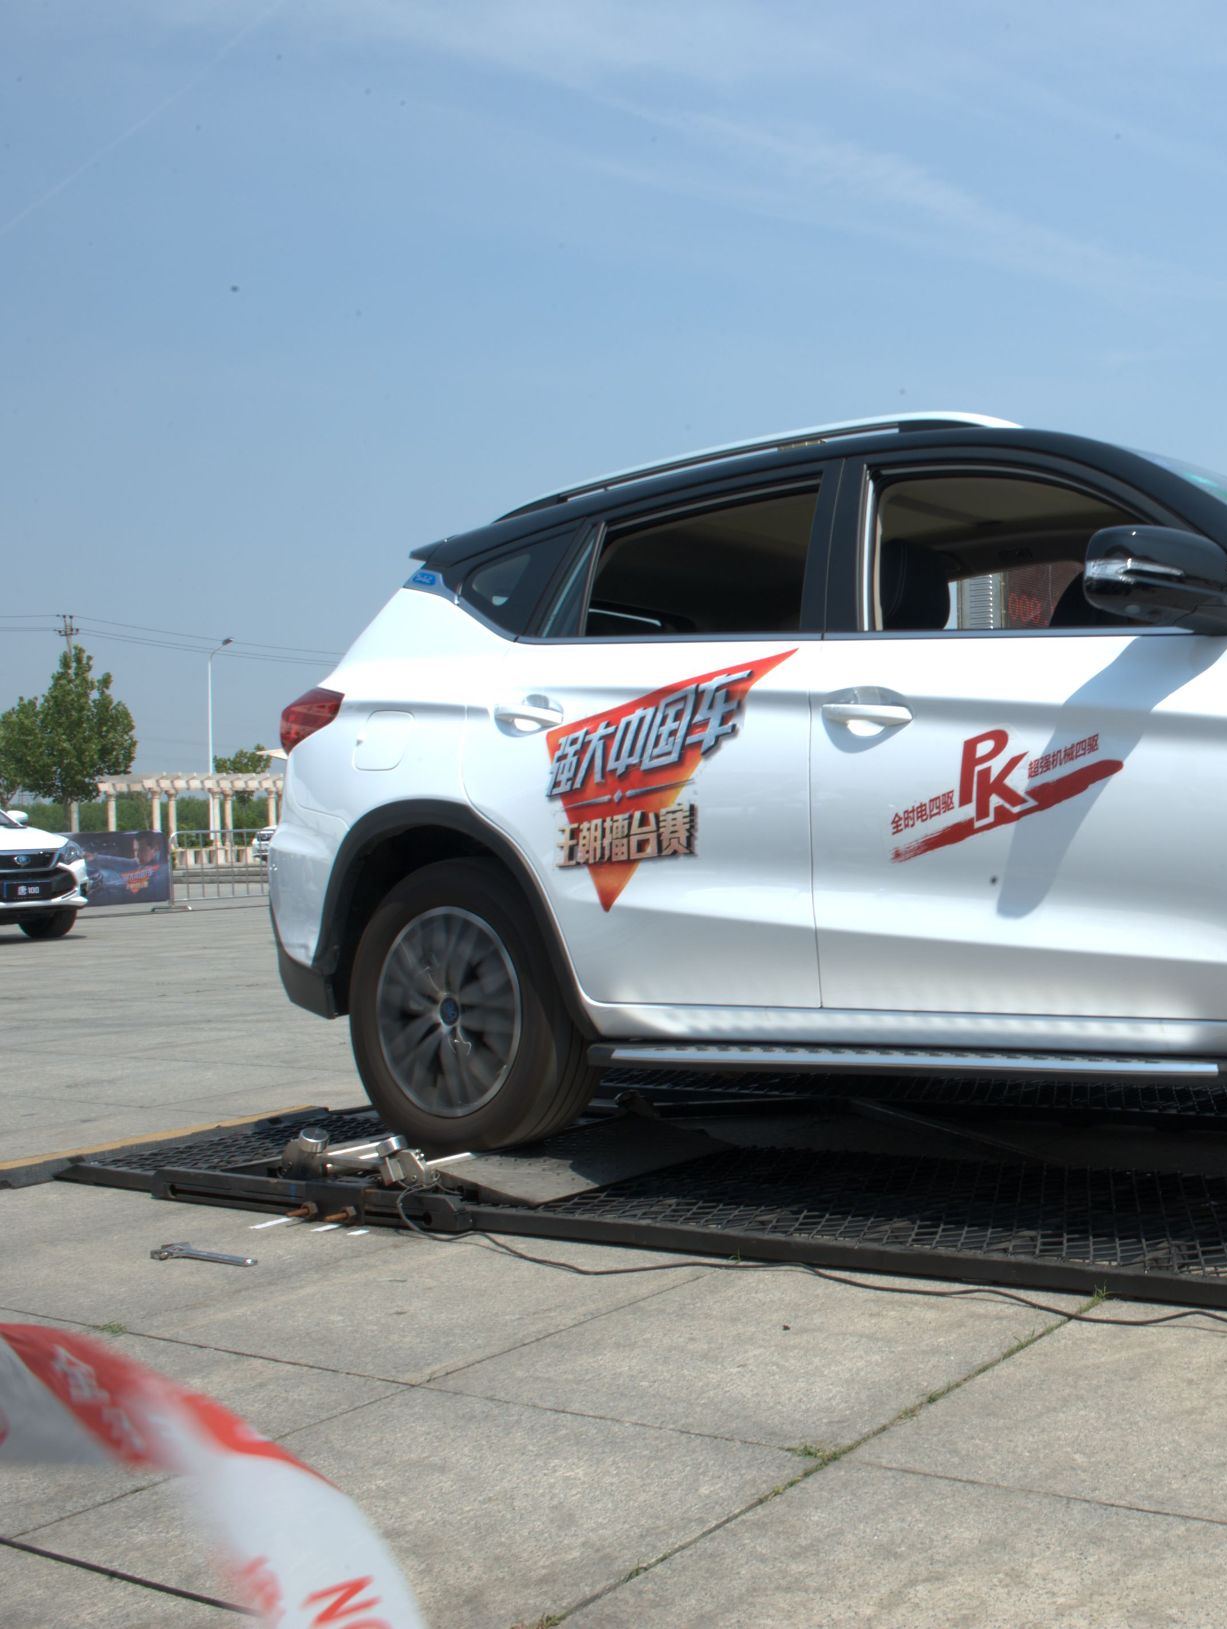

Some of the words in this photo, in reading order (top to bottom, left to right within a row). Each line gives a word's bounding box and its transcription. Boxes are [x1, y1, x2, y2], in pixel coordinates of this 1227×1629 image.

[546, 670, 753, 798] 强大中国车
[1027, 733, 1100, 780] 超强机械四驱
[959, 729, 1029, 823] PK
[555, 802, 697, 868] 王朝擂台赛
[890, 789, 955, 836] 全时电四驱
